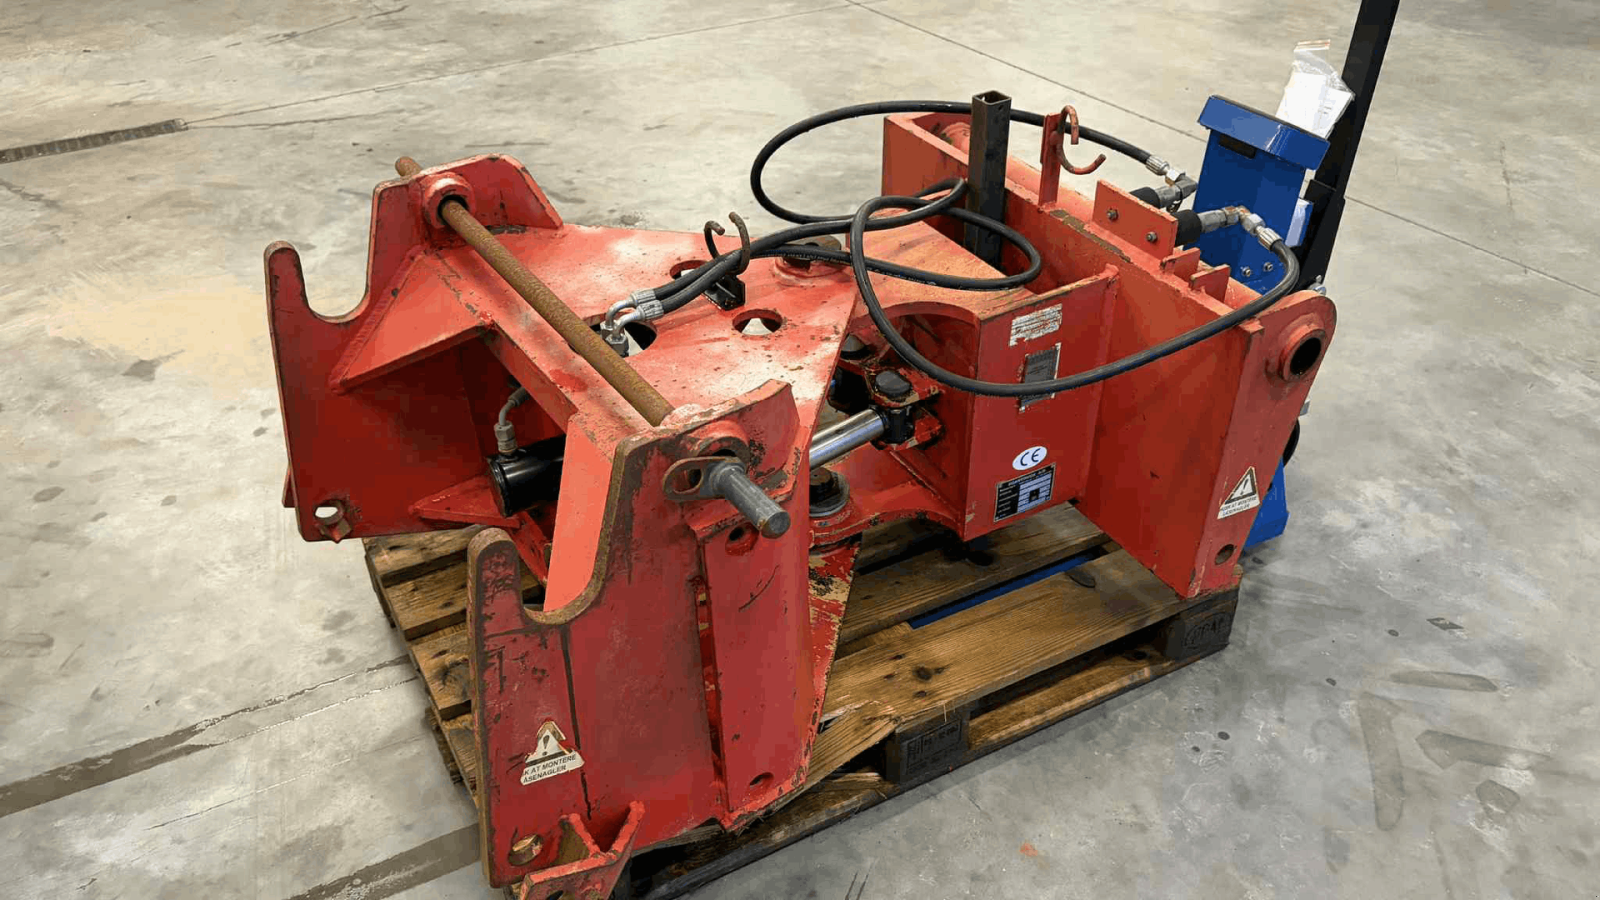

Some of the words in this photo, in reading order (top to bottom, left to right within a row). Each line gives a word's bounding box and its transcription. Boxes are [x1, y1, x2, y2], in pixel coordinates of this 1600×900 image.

[1020, 448, 1041, 466] CE
[531, 765, 541, 774] AT
[542, 754, 576, 770] MONTERE
